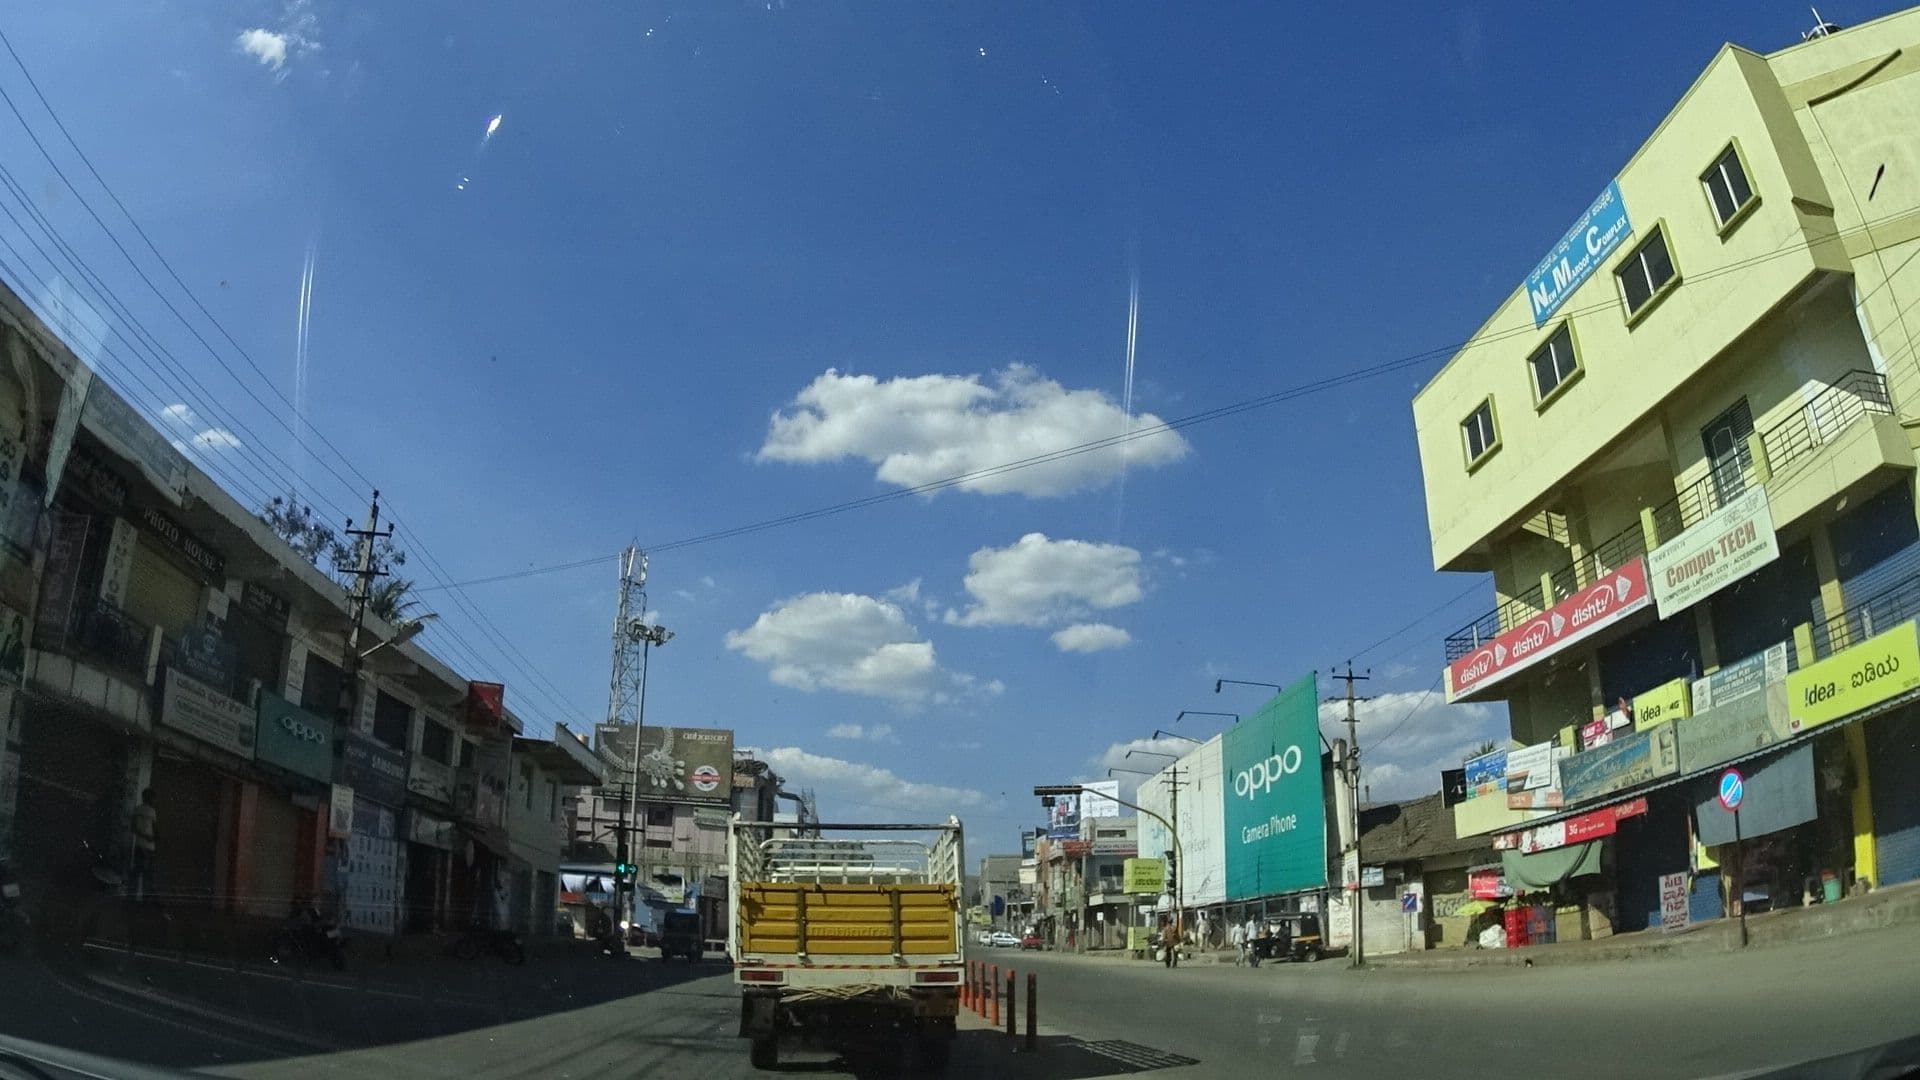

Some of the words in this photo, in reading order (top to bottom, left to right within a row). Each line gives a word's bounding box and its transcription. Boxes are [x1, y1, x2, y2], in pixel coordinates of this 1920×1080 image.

[1552, 253, 1591, 293] MAROOF
[1586, 214, 1627, 256] COMPLEX
[1665, 519, 1757, 588] Compu-TECH
[281, 716, 325, 744] oppo
[1235, 745, 1302, 800] oppo
[1242, 822, 1269, 844] Camera
[1270, 814, 1297, 836] Phone
[1568, 823, 1578, 836] 3G
